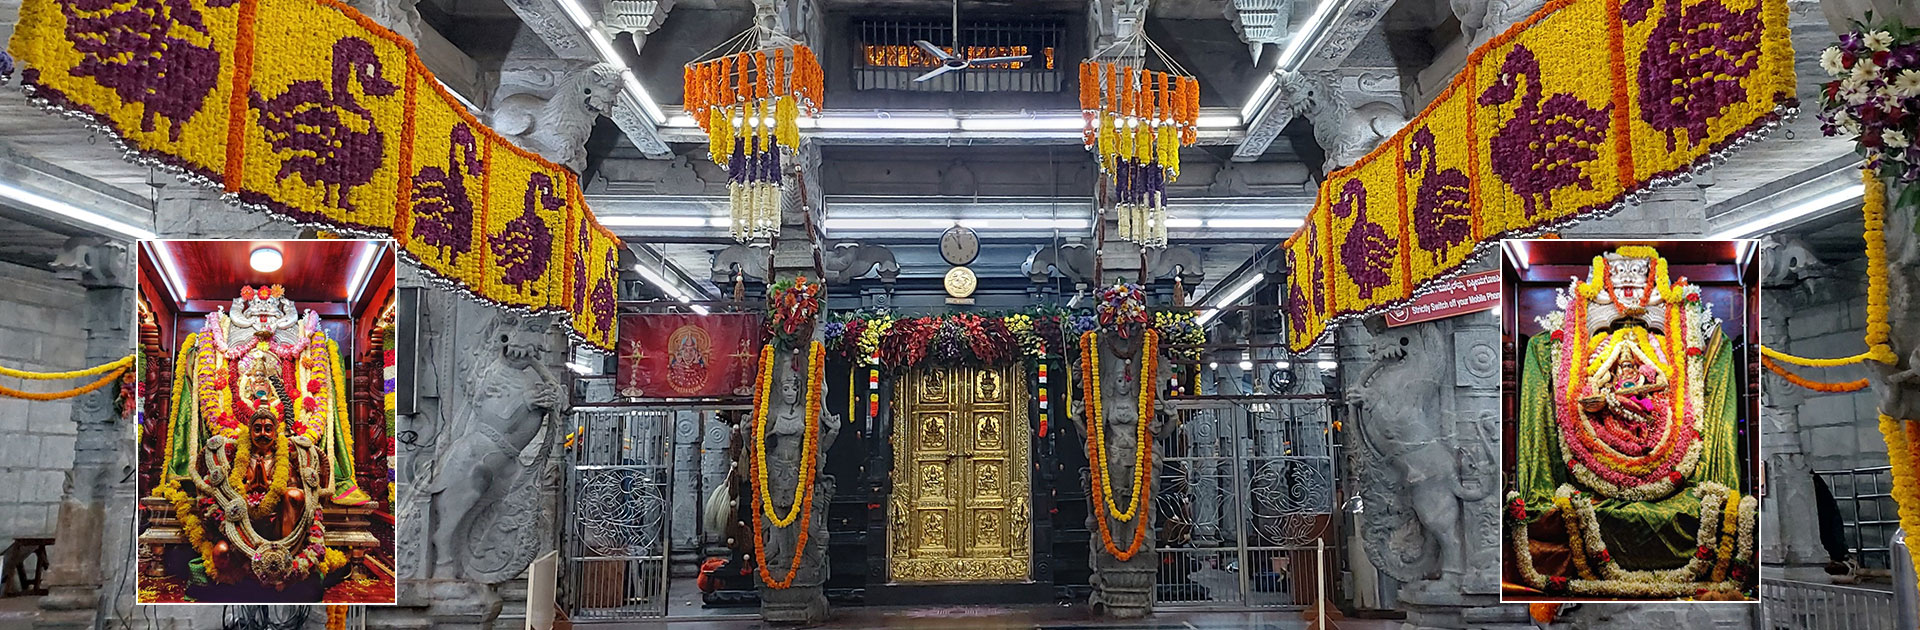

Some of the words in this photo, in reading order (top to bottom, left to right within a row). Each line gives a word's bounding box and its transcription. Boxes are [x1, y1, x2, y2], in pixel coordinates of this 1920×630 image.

[1412, 304, 1430, 314] Strictly
[1431, 301, 1449, 311] Switch
[1449, 299, 1457, 307] off
[1457, 298, 1468, 306] your
[1469, 293, 1486, 304] Mobile
[1487, 291, 1500, 301] Phon
